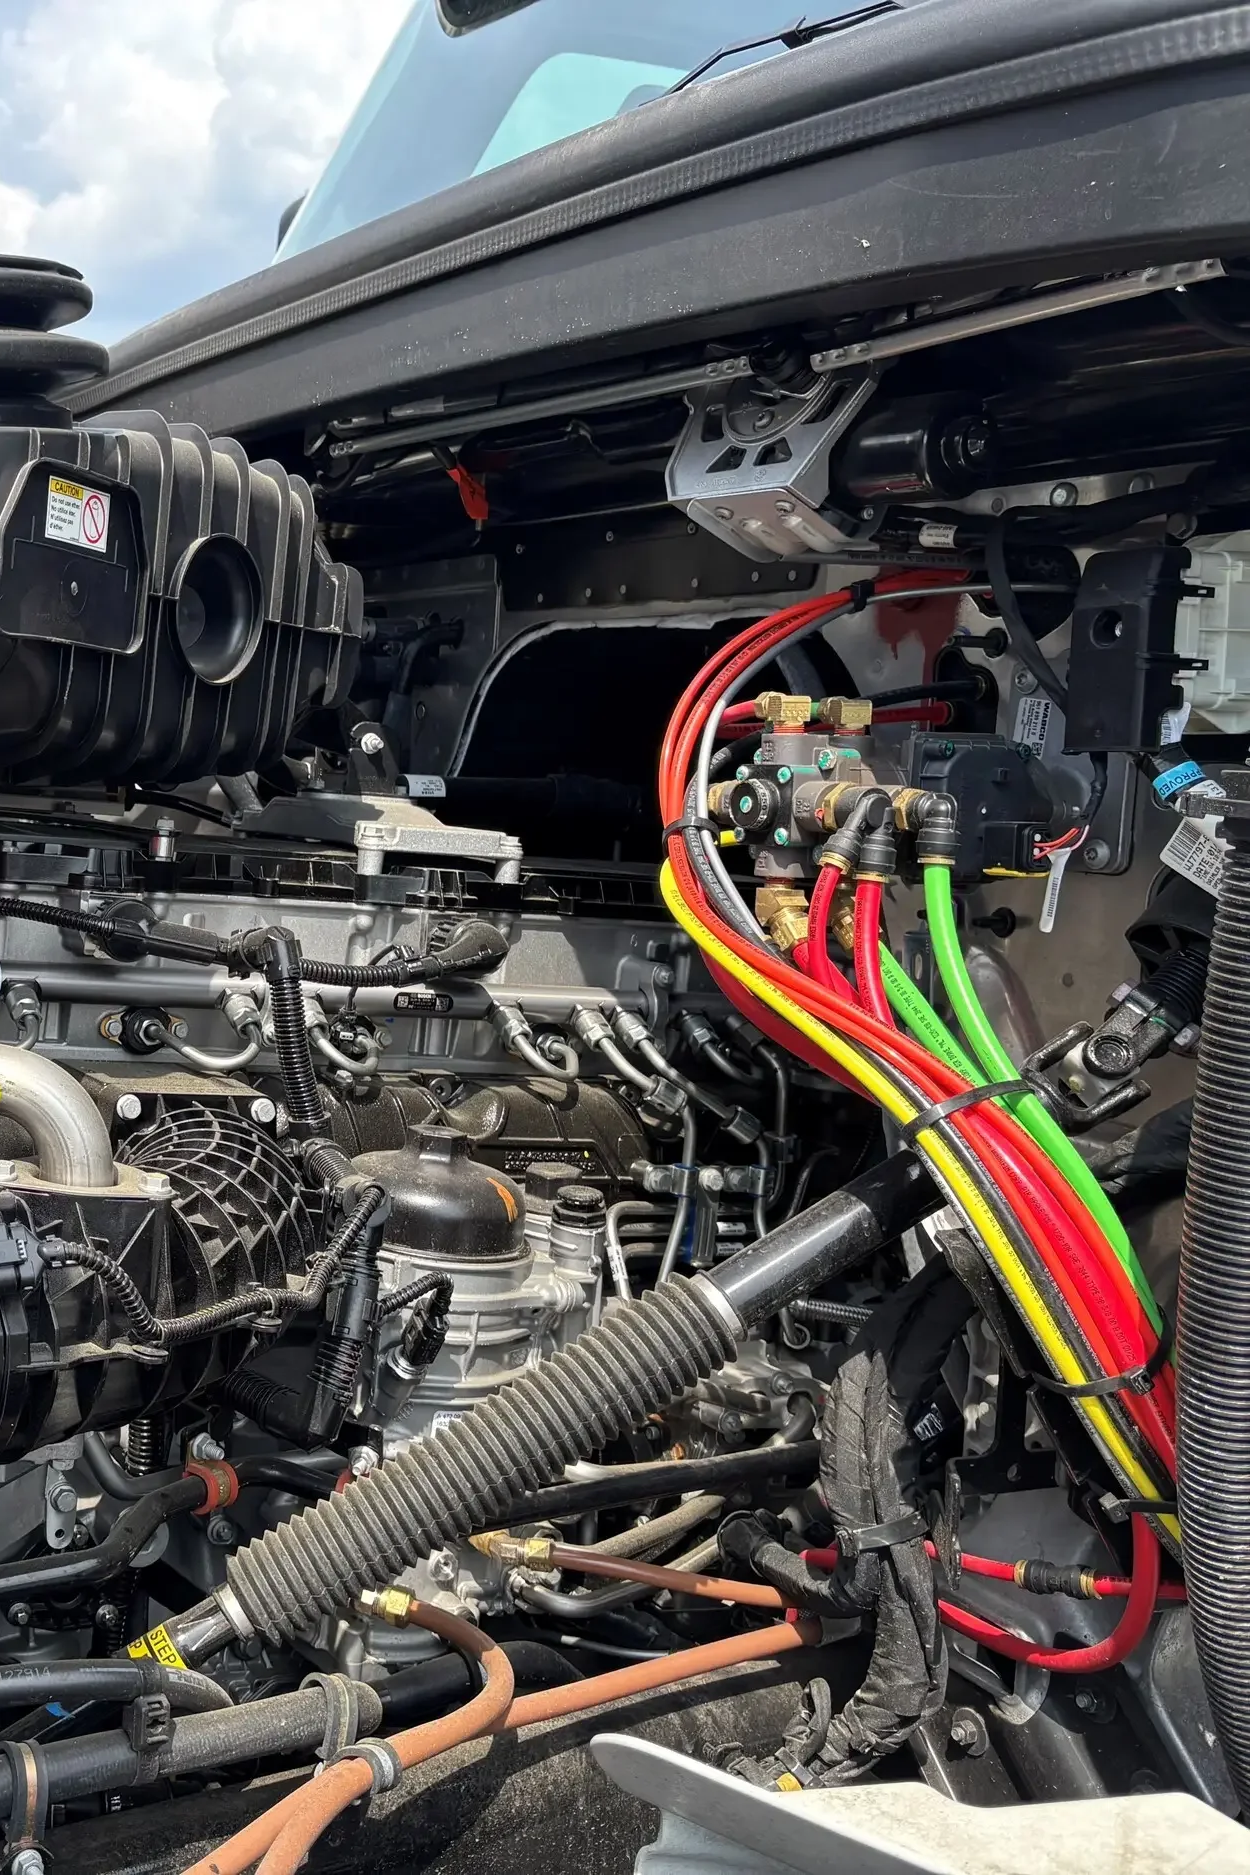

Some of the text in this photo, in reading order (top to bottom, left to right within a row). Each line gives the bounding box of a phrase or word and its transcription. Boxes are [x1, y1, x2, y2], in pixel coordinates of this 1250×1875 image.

[54, 482, 80, 498] CAUTION
[1038, 702, 1050, 741] WABCO
[1086, 1280, 1100, 1296] TYPE
[150, 1629, 177, 1664] STEP
